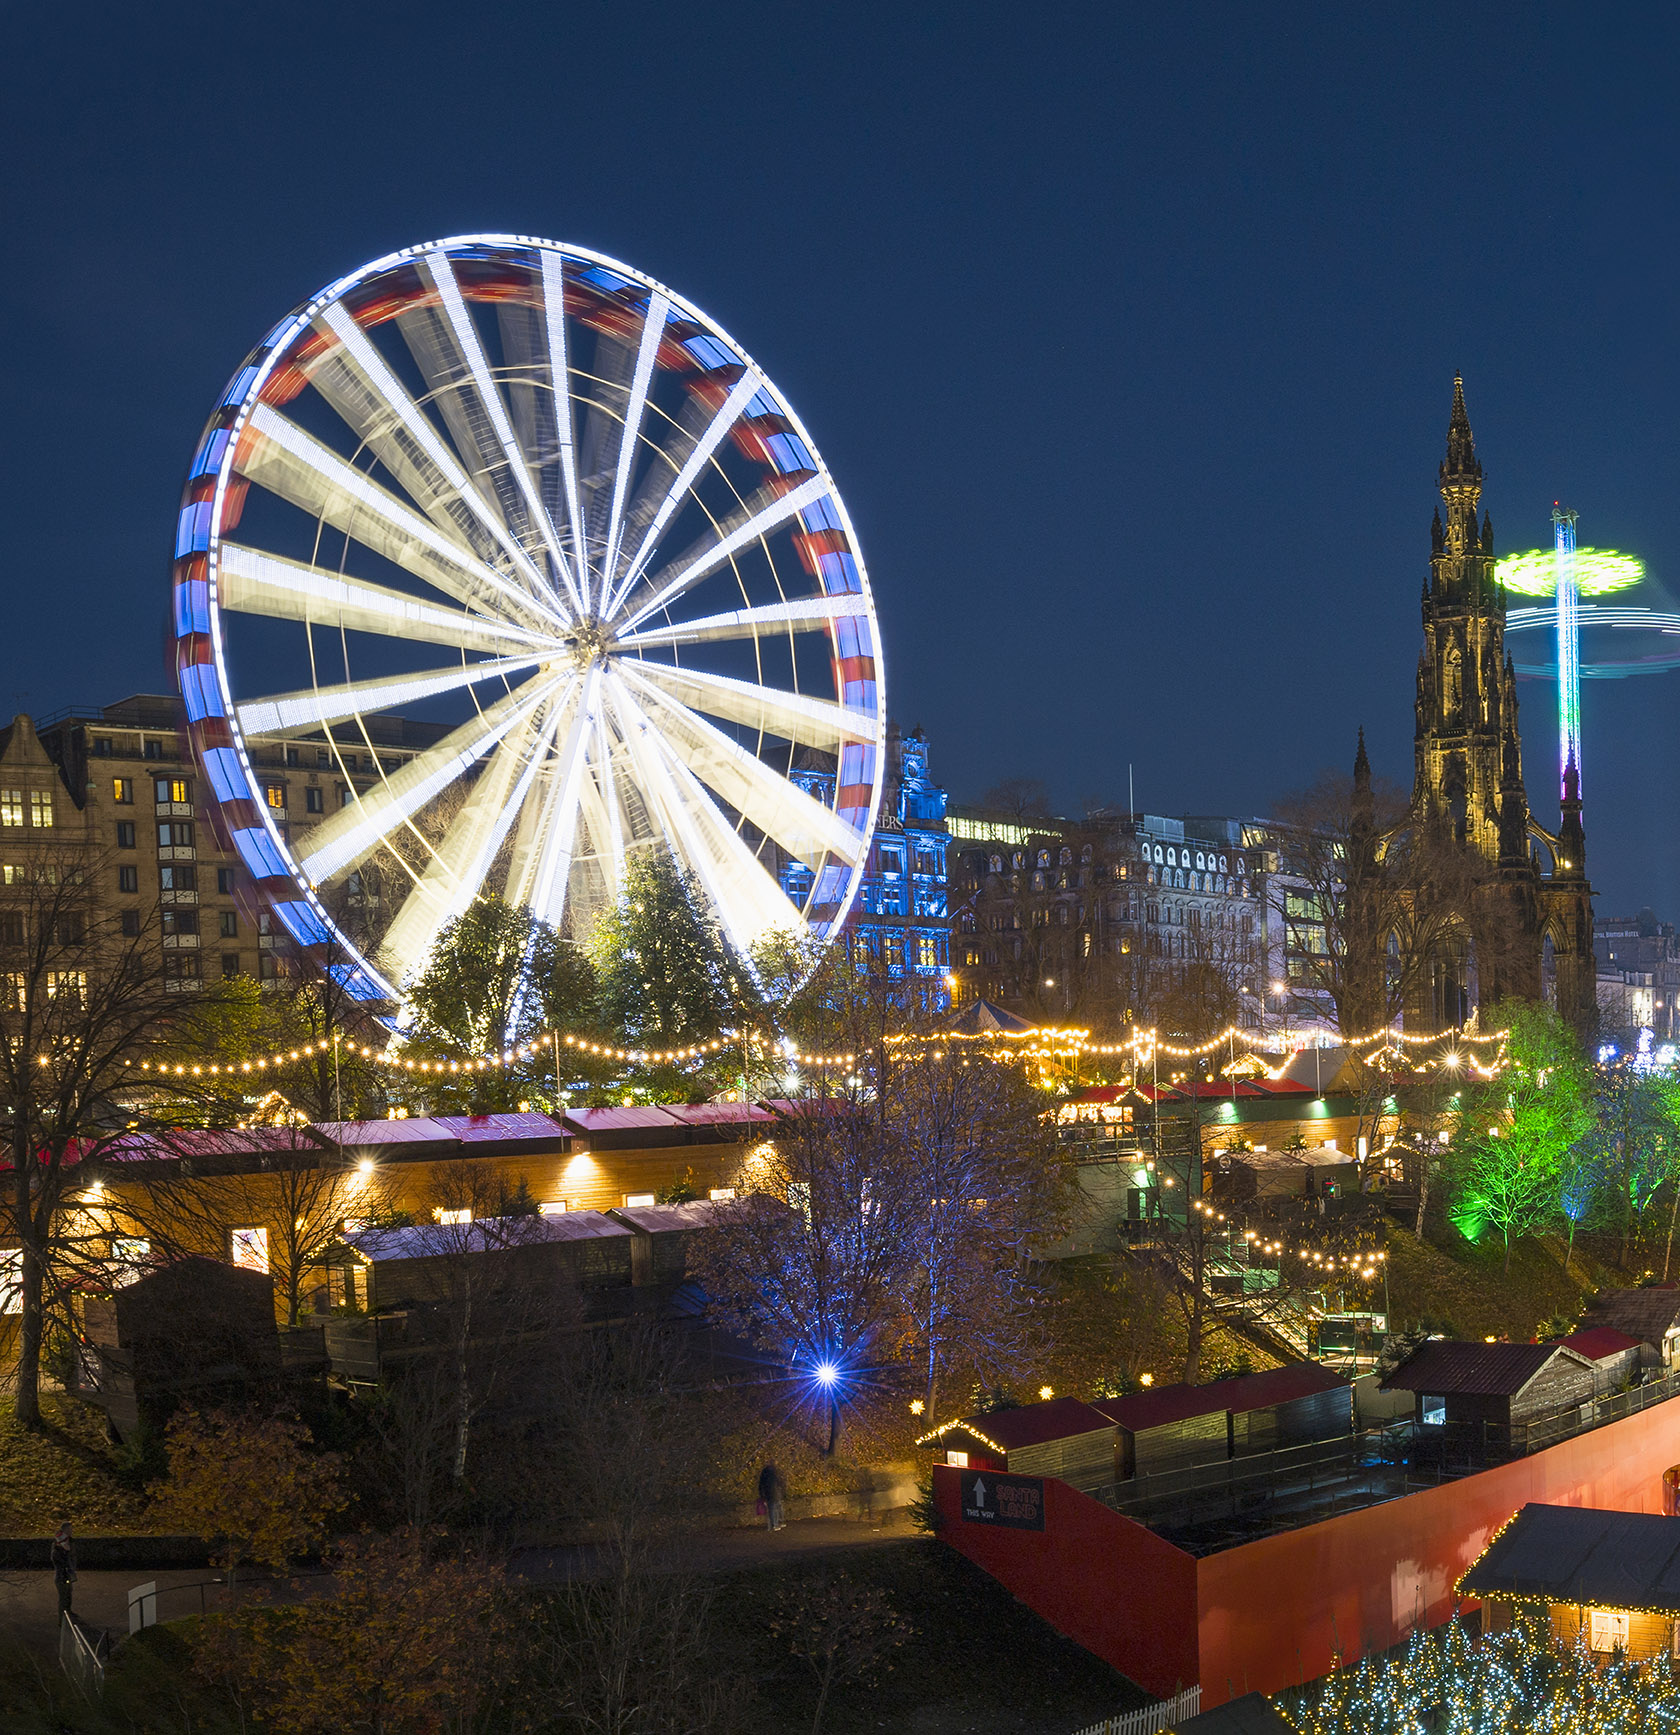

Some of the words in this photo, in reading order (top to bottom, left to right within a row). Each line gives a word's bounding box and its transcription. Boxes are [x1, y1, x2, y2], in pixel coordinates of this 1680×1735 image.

[996, 1484, 1040, 1505] SANTA
[966, 1508, 980, 1518] THIS
[980, 1510, 995, 1519] WAY
[1000, 1501, 1037, 1520] LAND
